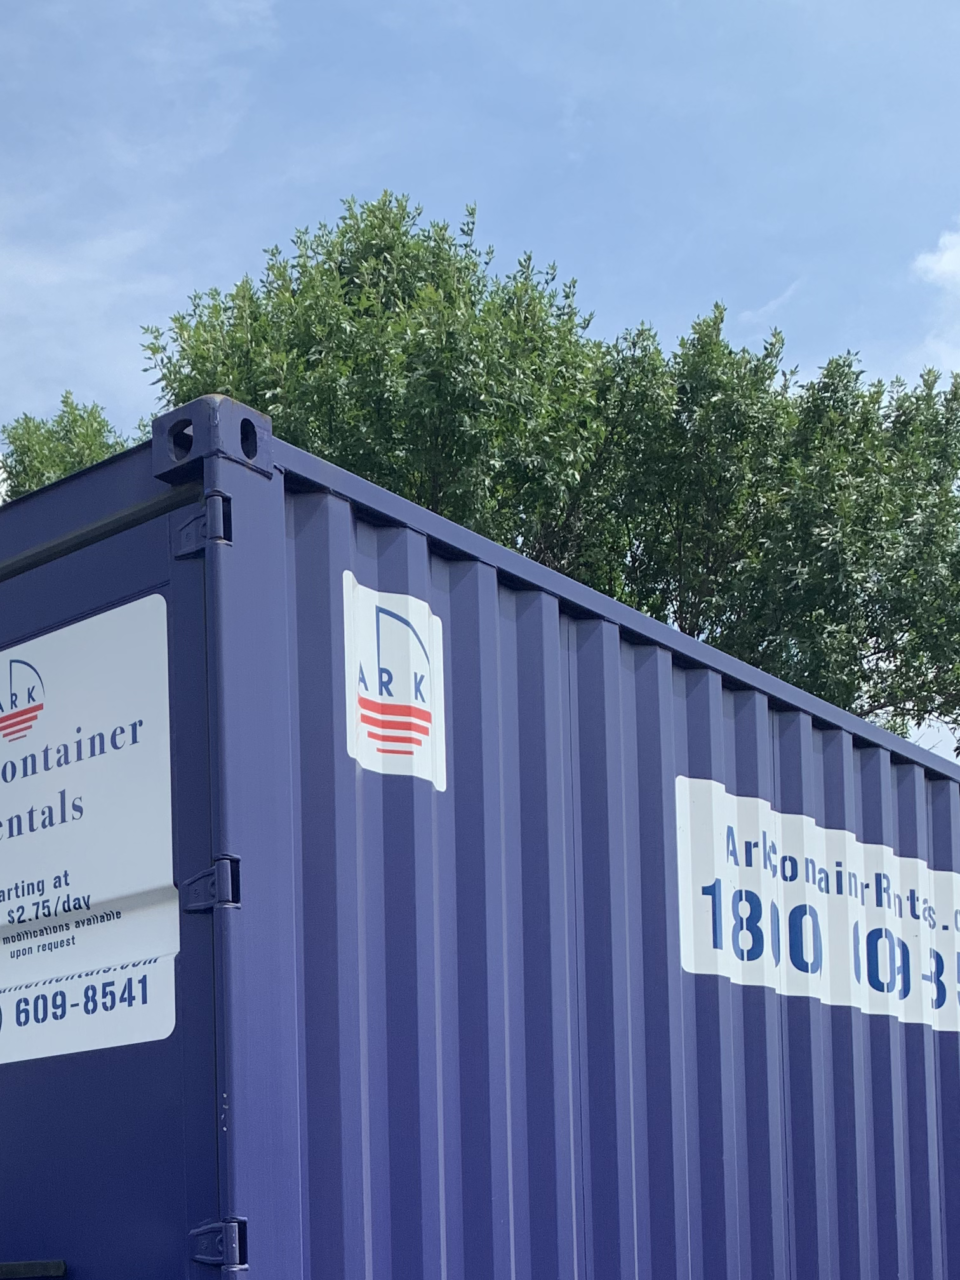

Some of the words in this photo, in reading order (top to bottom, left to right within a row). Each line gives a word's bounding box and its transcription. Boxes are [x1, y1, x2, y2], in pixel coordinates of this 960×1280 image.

[358, 660, 426, 703] ARK
[53, 870, 70, 890] at
[7, 894, 91, 925] $2.75/day
[2, 921, 70, 946] modifications
[74, 910, 122, 929] available
[10, 946, 33, 960] upon
[37, 935, 76, 954] request
[15, 974, 149, 1028] 609-8541
